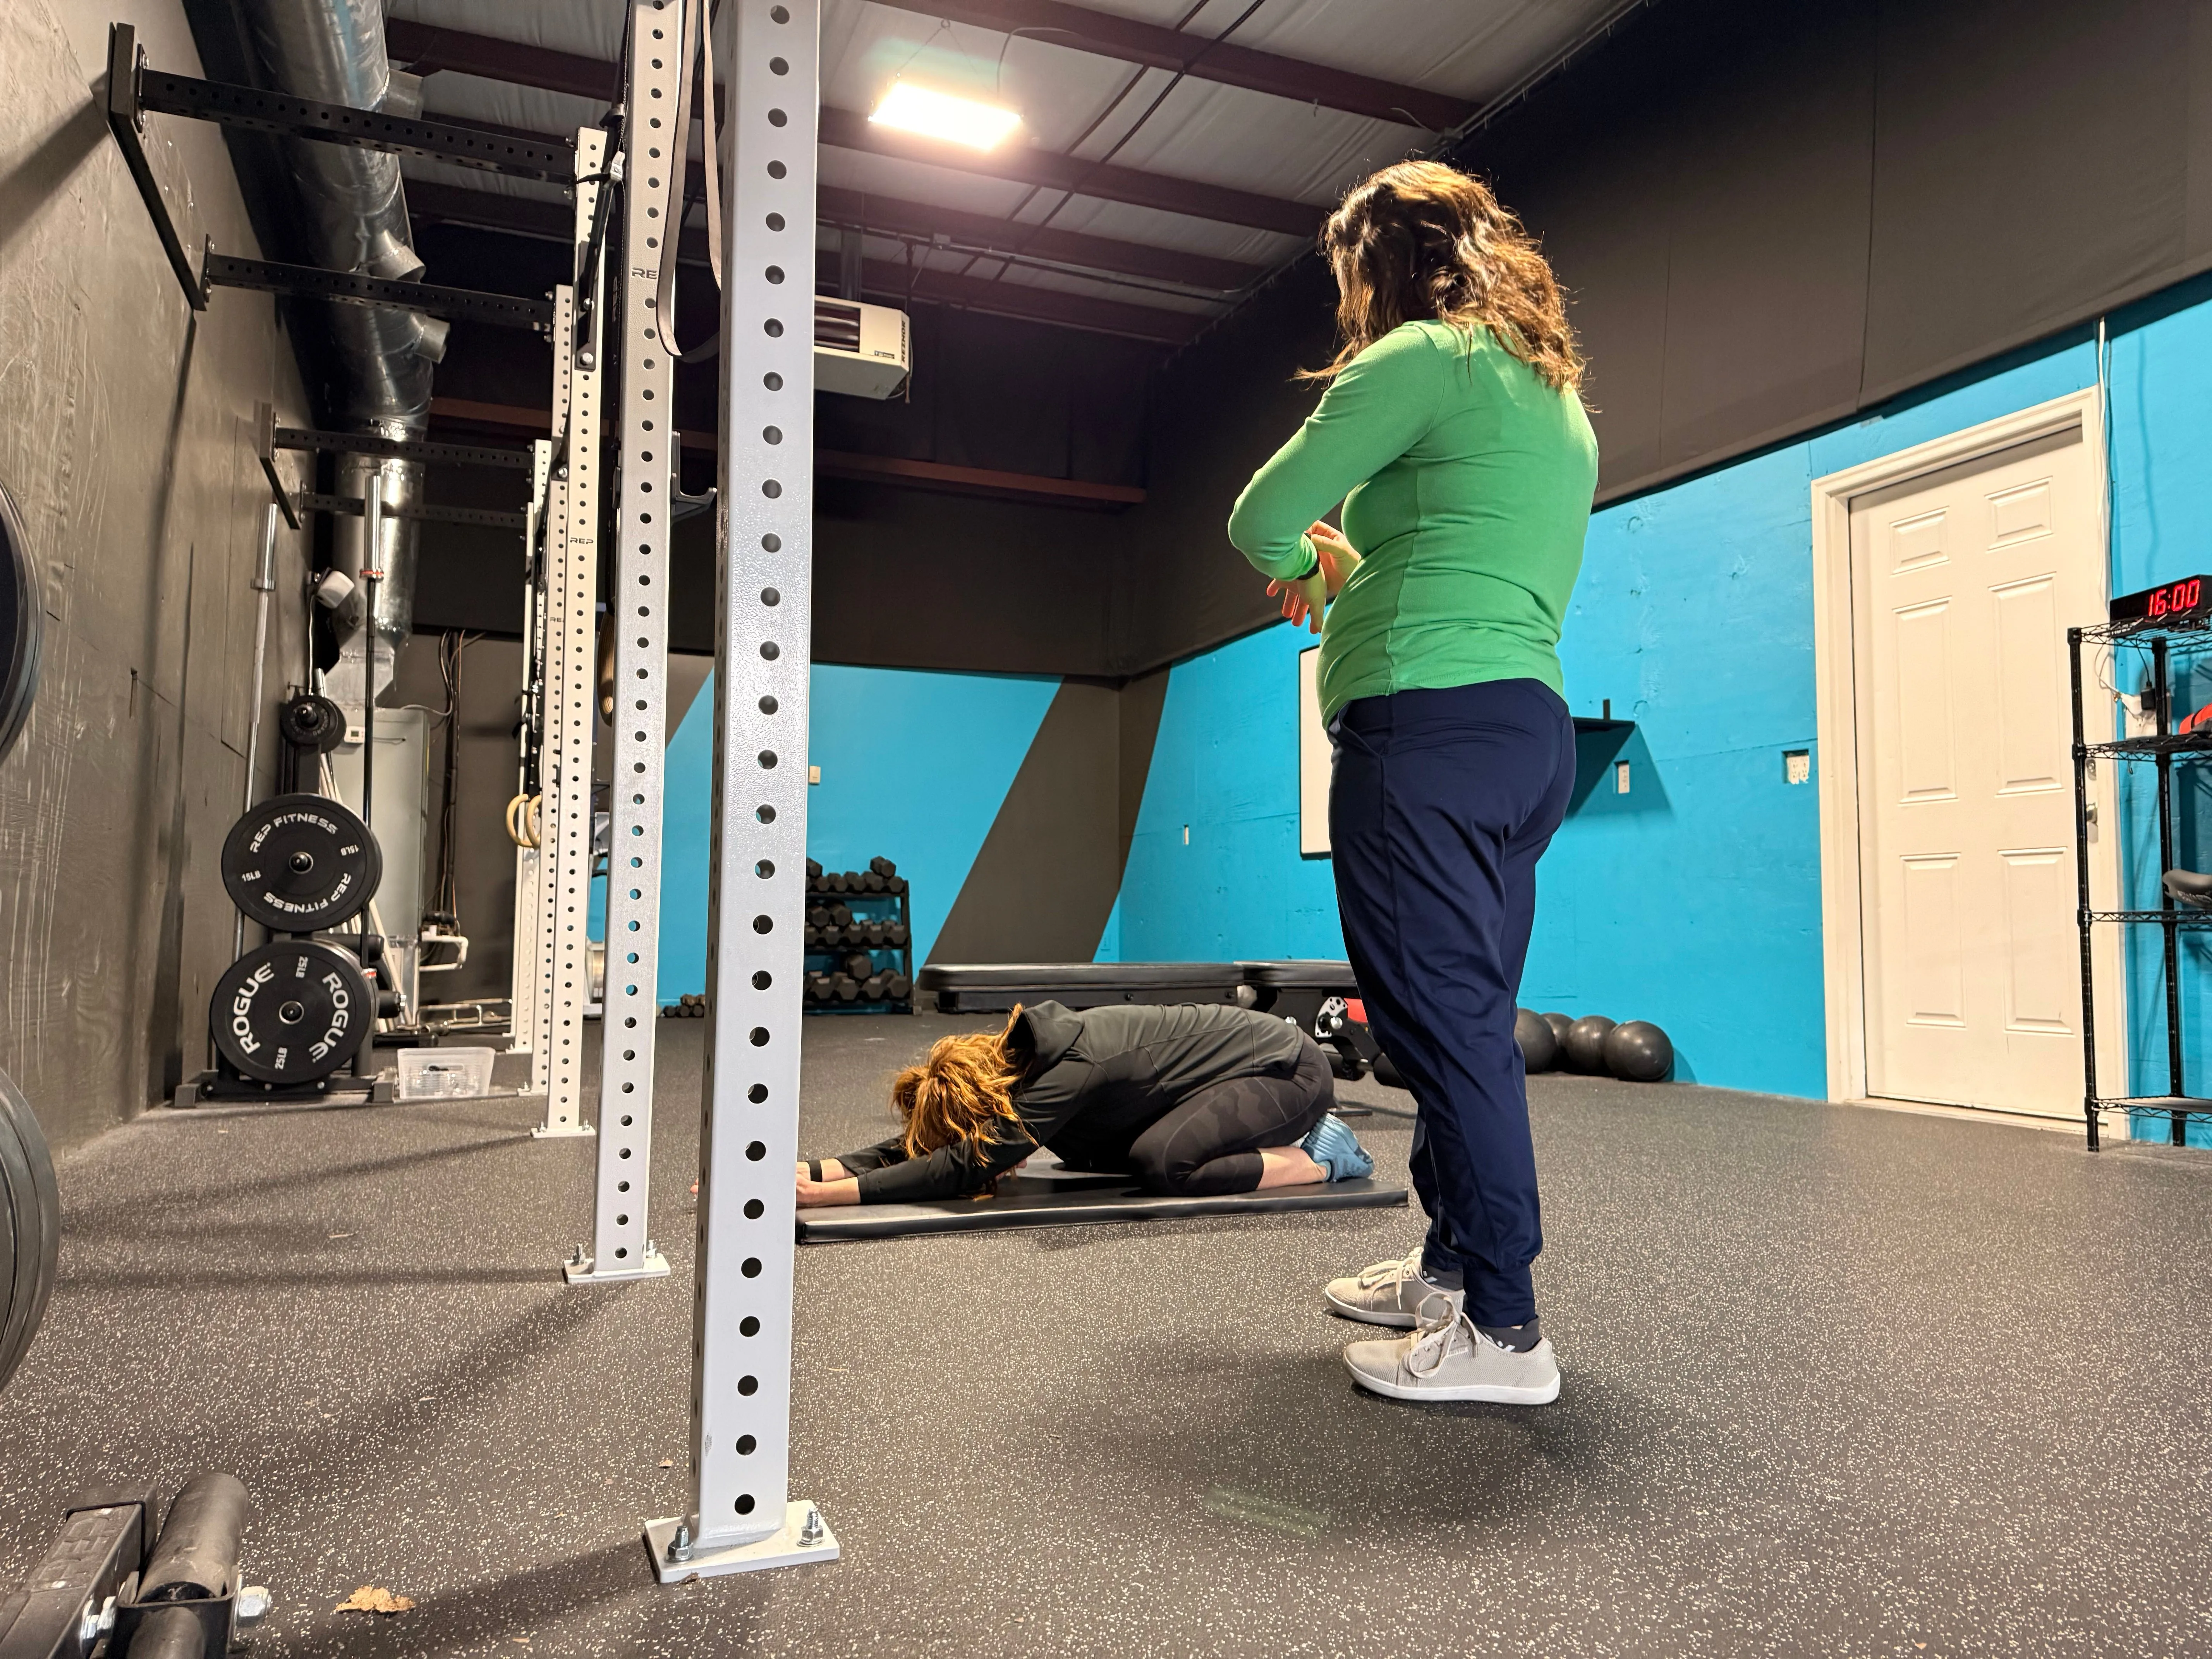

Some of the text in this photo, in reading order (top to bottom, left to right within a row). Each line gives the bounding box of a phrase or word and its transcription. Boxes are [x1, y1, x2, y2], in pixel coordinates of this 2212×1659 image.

[632, 267, 657, 280] RE
[2148, 579, 2200, 616] 16:00
[249, 812, 338, 853] REP FITNESS
[241, 870, 261, 882] 15LB
[263, 872, 351, 914] REP FITNESS
[233, 963, 275, 1054] ROGUE
[309, 972, 349, 1062] ROGUE
